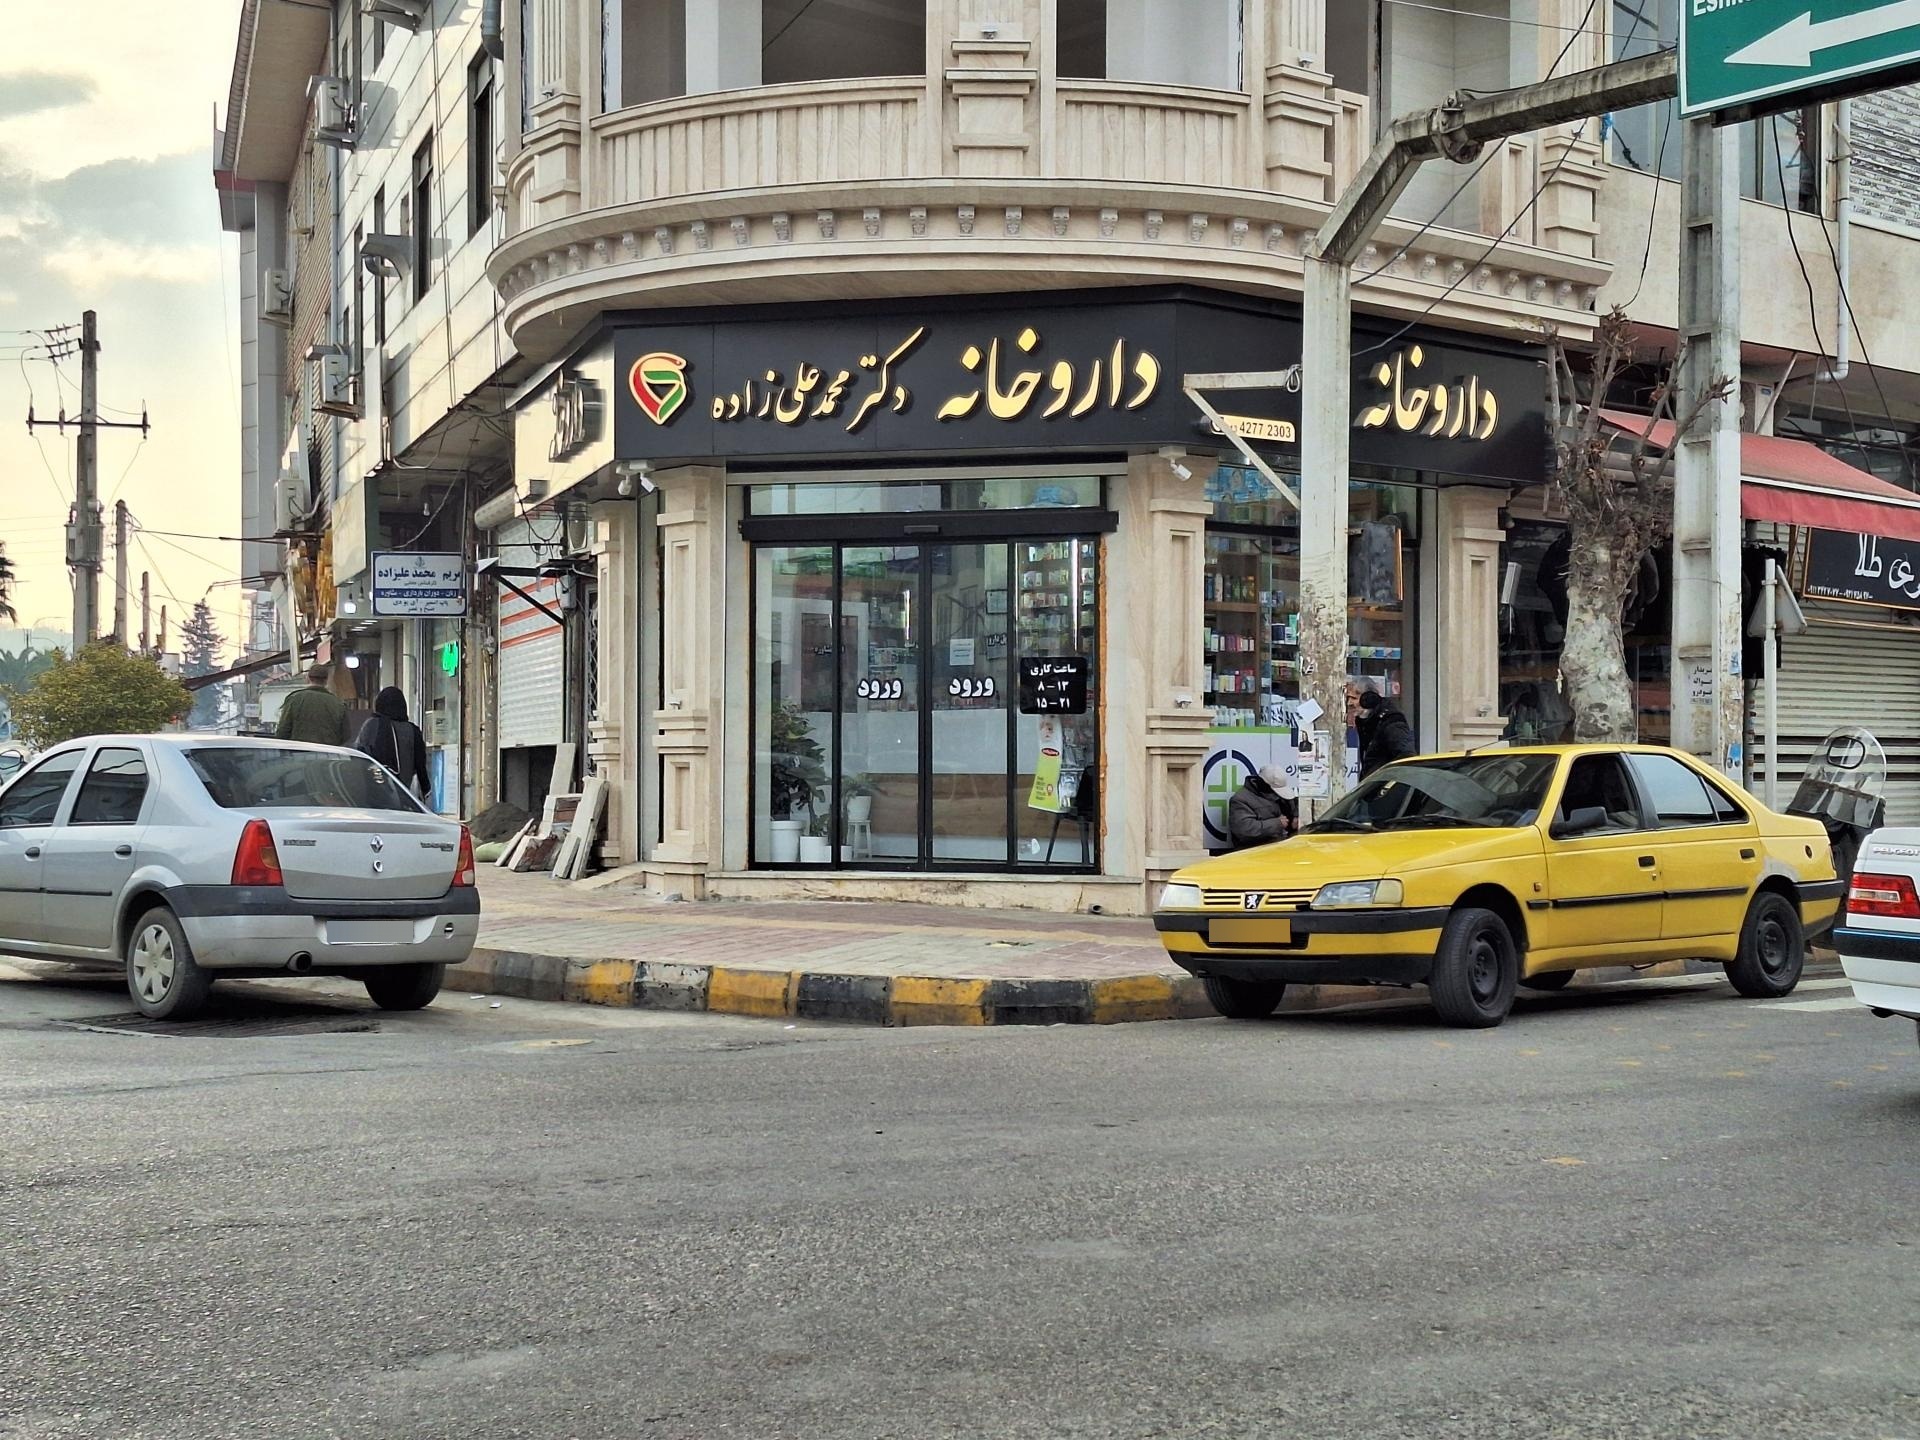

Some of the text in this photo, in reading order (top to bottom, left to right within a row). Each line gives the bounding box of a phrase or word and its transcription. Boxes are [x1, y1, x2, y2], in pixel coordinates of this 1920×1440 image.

[846, 326, 925, 431] دکتر
[937, 327, 1161, 422] داروخانه
[1363, 345, 1498, 441] داروخانه
[1240, 421, 1263, 434] 4277
[1267, 424, 1291, 438] 2303
[412, 568, 436, 578] محمد
[1030, 663, 1077, 676] ساعت کاری
[857, 680, 902, 699] ورود
[949, 678, 994, 697] ورود
